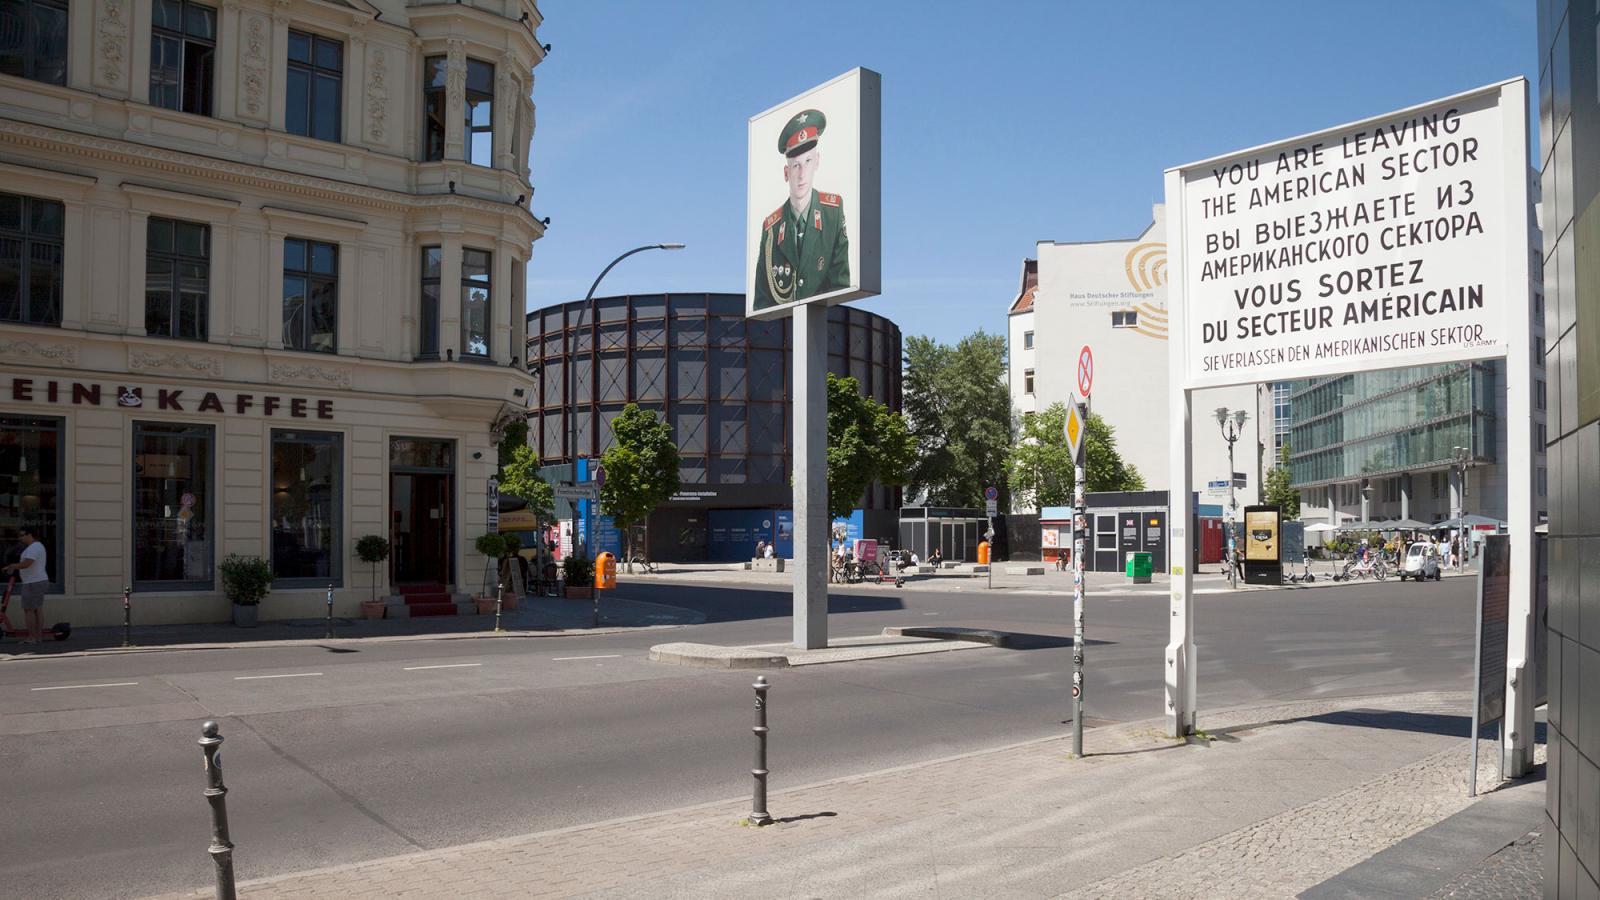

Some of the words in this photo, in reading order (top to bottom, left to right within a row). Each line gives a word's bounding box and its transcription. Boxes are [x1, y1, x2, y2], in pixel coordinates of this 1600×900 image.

[1201, 197, 1236, 220] THE
[1249, 163, 1366, 210] AMERICAN
[1381, 137, 1479, 181] SECTOR
[1213, 159, 1260, 189] YOU
[1275, 143, 1323, 175] ARE
[1342, 108, 1461, 160] LEAVING
[1201, 232, 1369, 282] АМЕРИКАНСКОГО
[1380, 211, 1484, 251] СЕКТОРА
[1206, 229, 1241, 254] ВЫ
[1255, 192, 1416, 246] ВЫЕЗЖАЕТЕ
[1436, 179, 1475, 210] ИЗ
[1202, 320, 1228, 344] DU
[1236, 305, 1333, 340] SECTEUR
[1343, 284, 1484, 326] AMÉRICAIN
[1234, 279, 1302, 310] VOUS
[1318, 259, 1424, 298] SORTEZ
[1203, 355, 1219, 371] SIE
[1221, 347, 1284, 369] VERLASSEN
[1288, 344, 1310, 362] DEN
[1314, 329, 1425, 359] AMERIKANISCHEN
[1431, 325, 1483, 345] SEKTOR
[13, 378, 101, 406] EIN
[158, 389, 334, 419] KAFFEE
